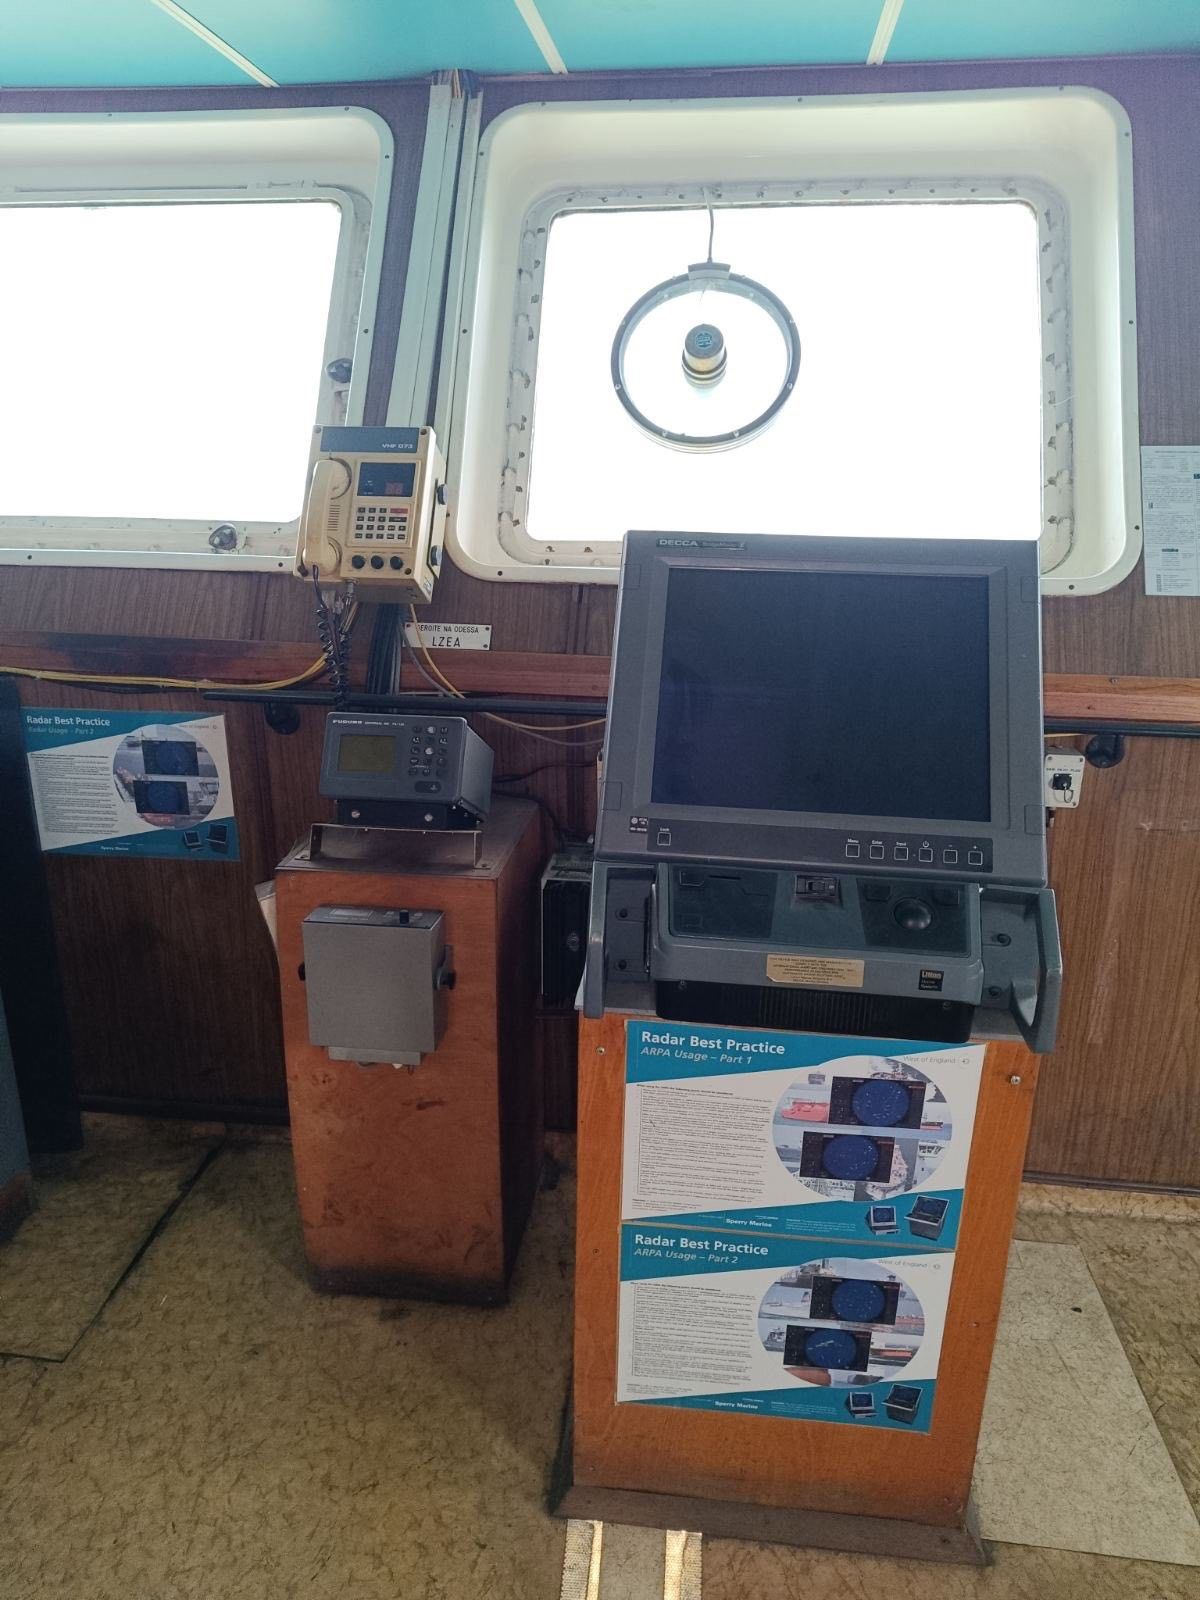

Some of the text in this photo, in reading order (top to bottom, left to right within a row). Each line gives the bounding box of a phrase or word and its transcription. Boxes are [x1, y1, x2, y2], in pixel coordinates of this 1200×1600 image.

[659, 538, 698, 547] DECCA
[418, 624, 441, 632] EROITE
[454, 626, 479, 634] ODESSA
[432, 636, 461, 648] LZEA
[26, 715, 111, 727] Radar Best Practice
[642, 1031, 786, 1055] Radar Best Practice
[640, 1046, 671, 1057] ARPA
[674, 1049, 708, 1062] Usage
[720, 1054, 743, 1064] Part
[746, 1056, 752, 1065] 1
[635, 1234, 769, 1256] Radar Best Practice
[634, 1248, 662, 1257] ARPA
[666, 1250, 697, 1262] Usage
[708, 1254, 730, 1264] Part
[731, 1256, 739, 1264] 2
